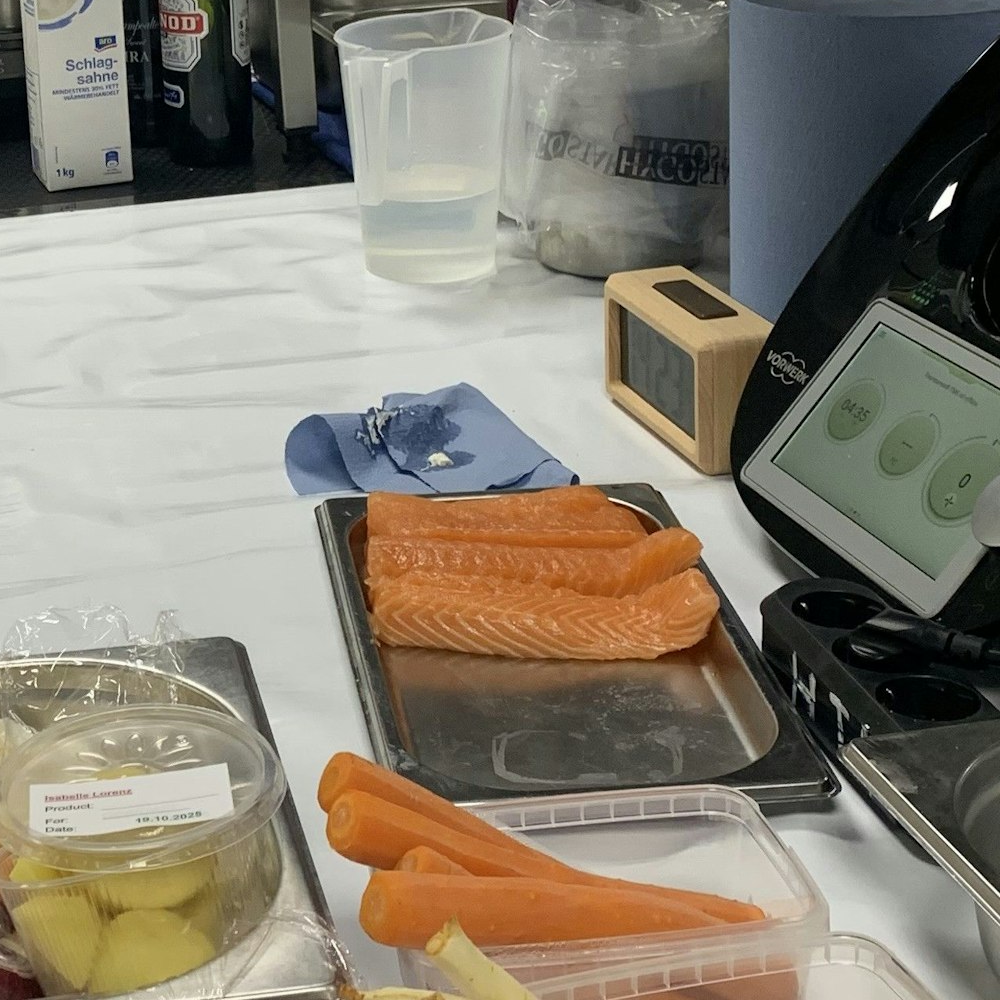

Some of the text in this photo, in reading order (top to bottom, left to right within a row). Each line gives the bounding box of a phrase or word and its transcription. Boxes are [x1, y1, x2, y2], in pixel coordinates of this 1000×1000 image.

[66, 57, 118, 71] Schlag-
[77, 72, 119, 85] sahne
[56, 168, 75, 178] 1 kg
[766, 349, 810, 385] VORWERK
[958, 473, 972, 489] 0
[45, 789, 133, 803] Isabelle Lorenz
[136, 811, 202, 824] 19.10.2025
